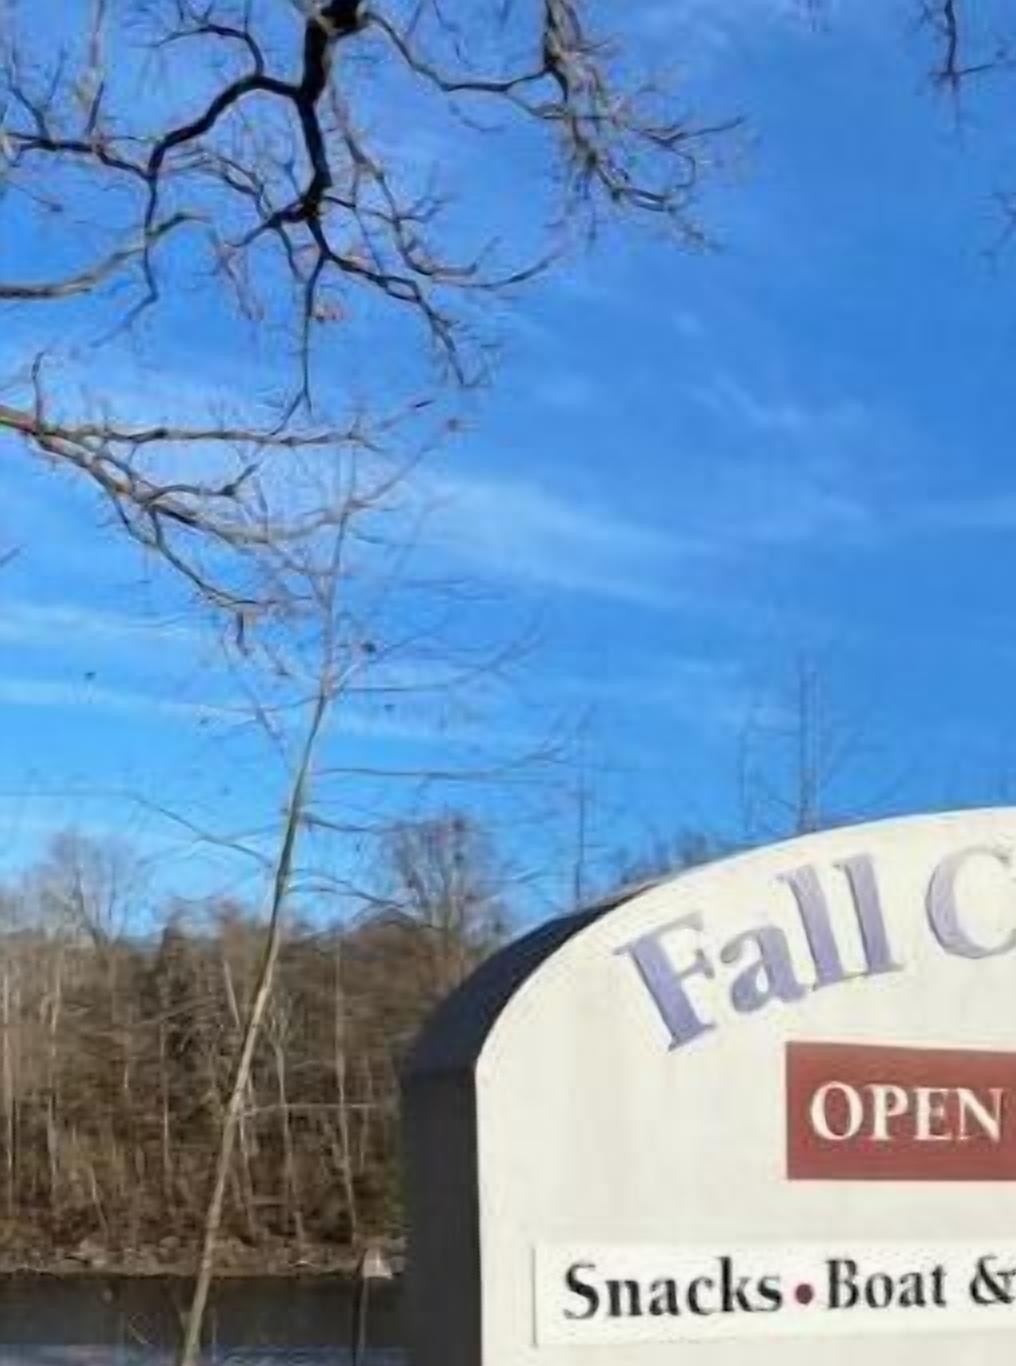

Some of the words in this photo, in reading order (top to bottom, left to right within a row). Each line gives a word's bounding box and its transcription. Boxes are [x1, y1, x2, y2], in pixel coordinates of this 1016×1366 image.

[613, 853, 904, 1052] Fall
[809, 1080, 1004, 1144] OPEN
[562, 1256, 784, 1320] Snacks
[825, 1258, 947, 1310] Boat
